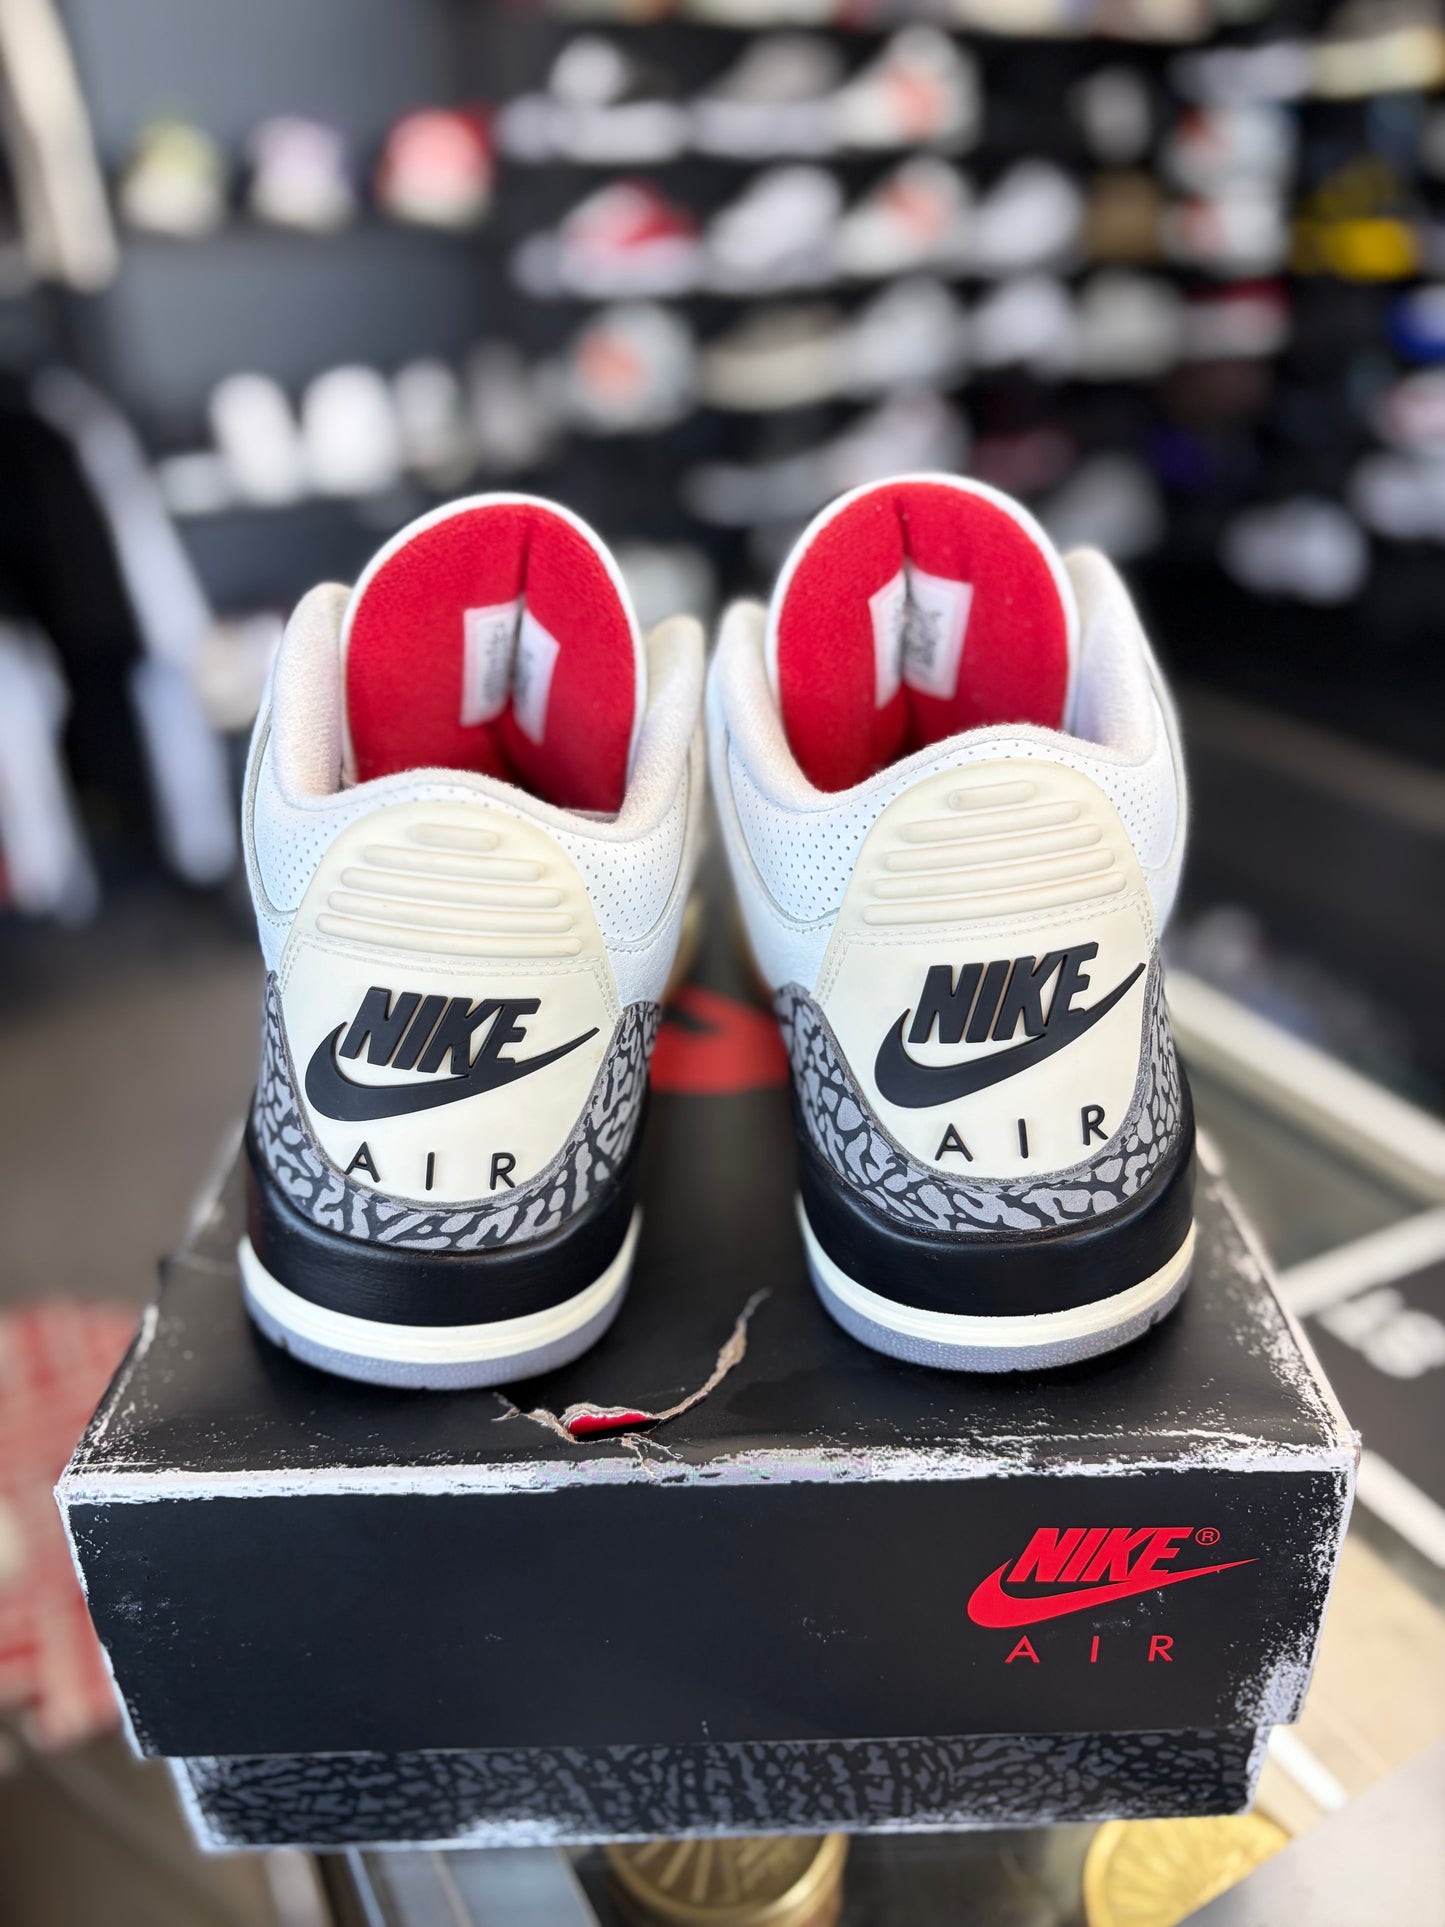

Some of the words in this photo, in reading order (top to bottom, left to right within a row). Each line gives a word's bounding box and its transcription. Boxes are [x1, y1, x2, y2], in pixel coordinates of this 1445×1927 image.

[908, 941, 1099, 1043] NIKE
[338, 985, 542, 1076] NIKE
[934, 1104, 1109, 1162] AIR
[344, 1141, 516, 1191] AIR
[1005, 1635, 1175, 1663] AIR
